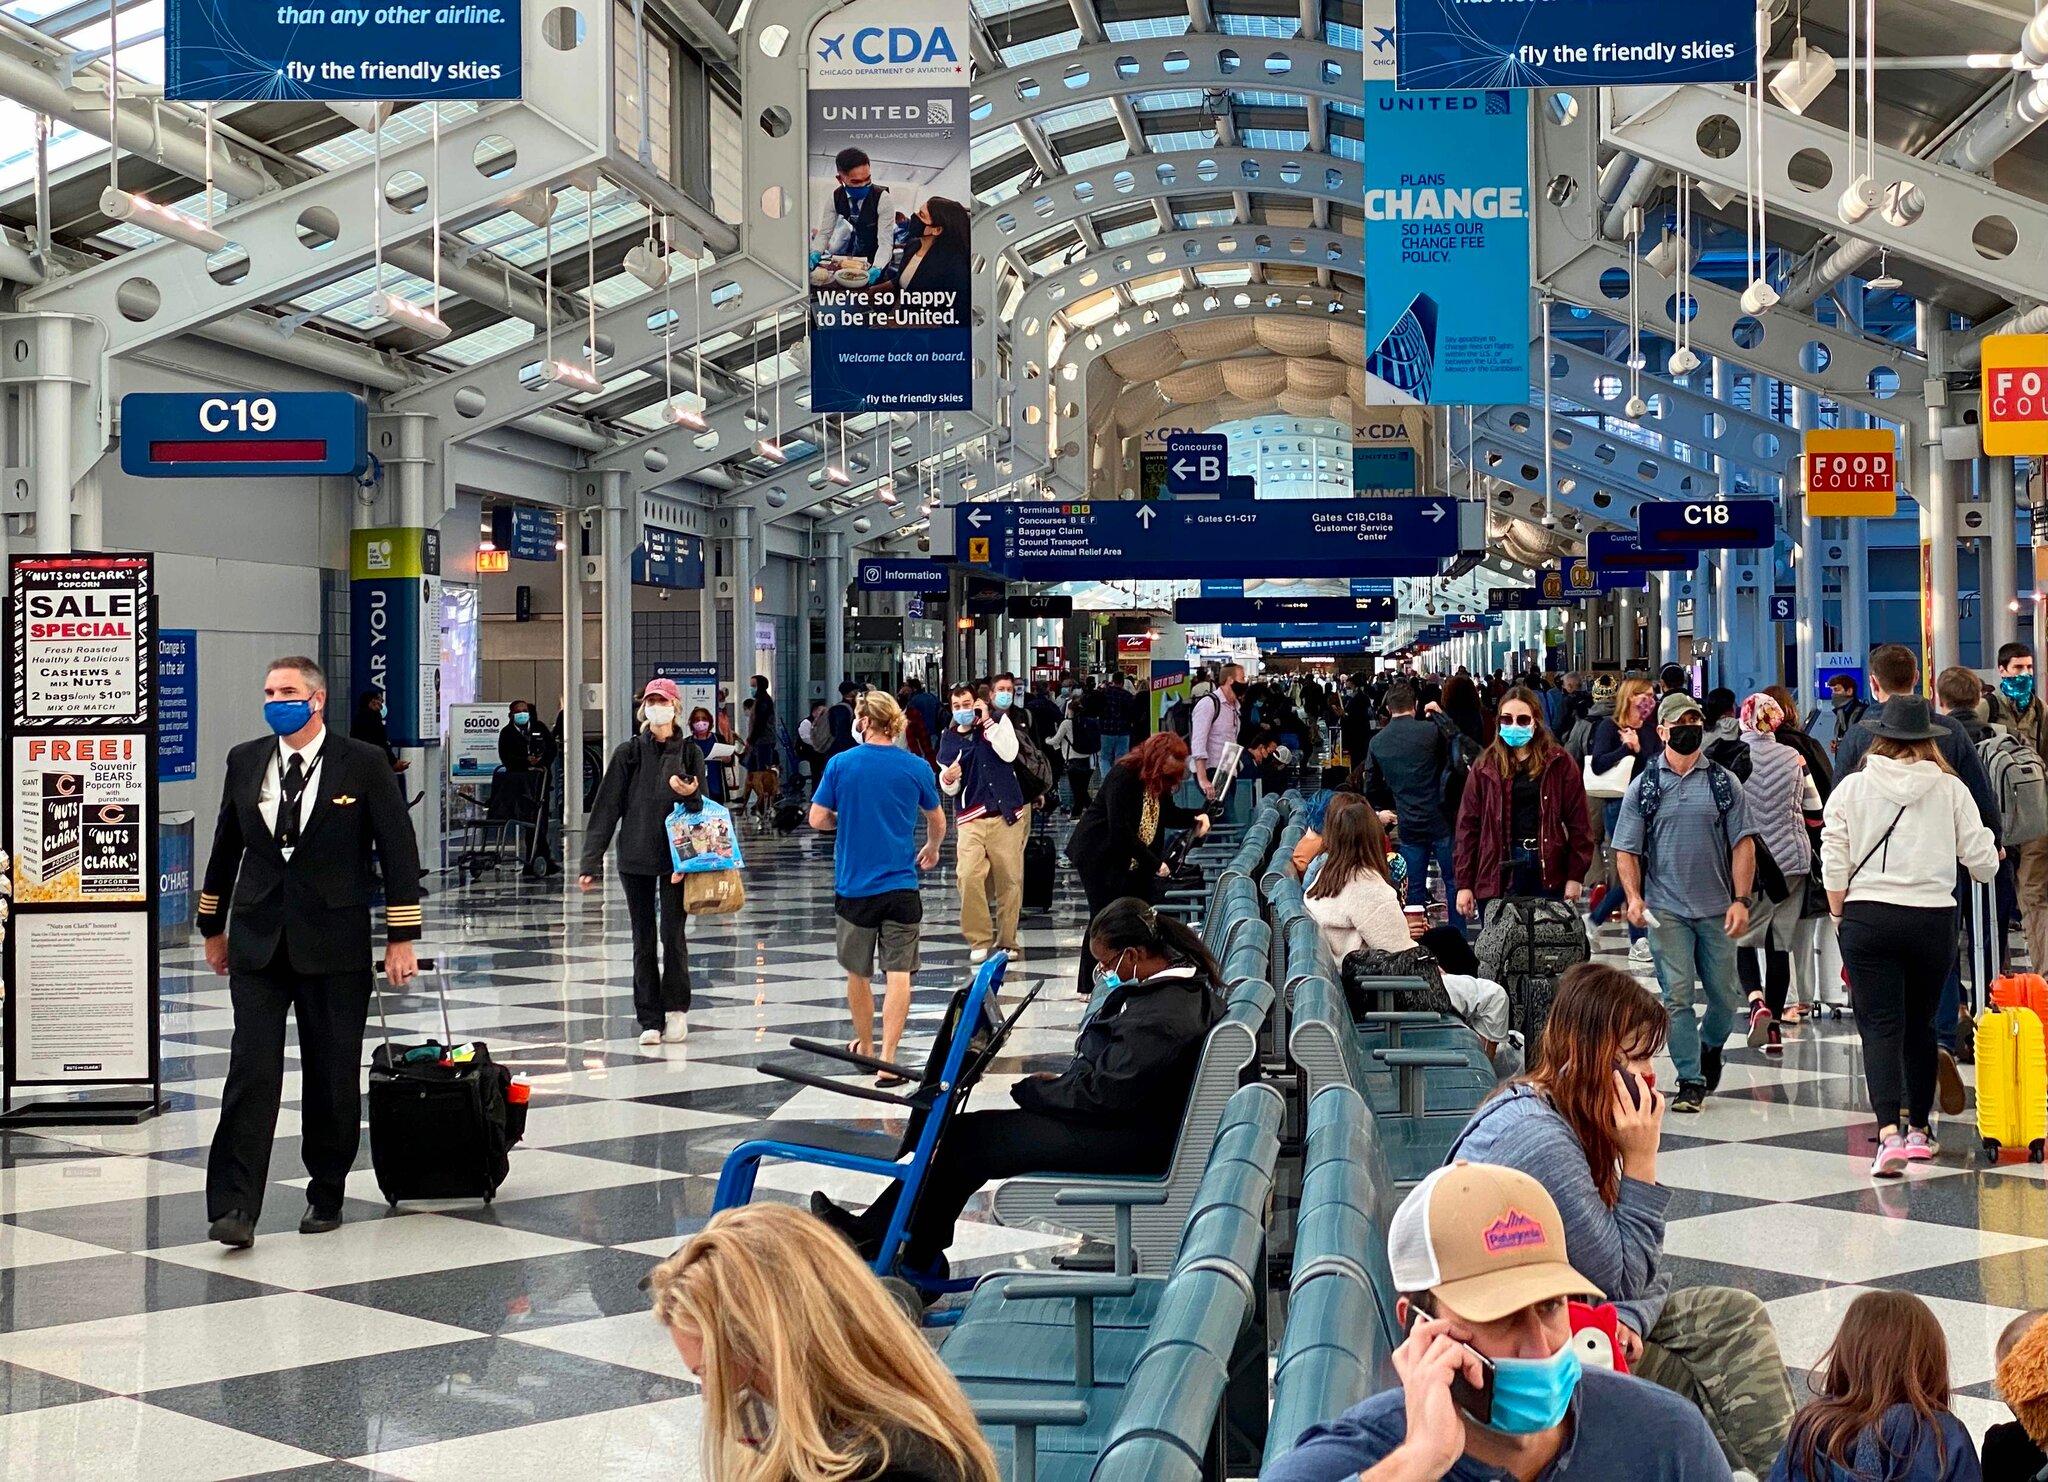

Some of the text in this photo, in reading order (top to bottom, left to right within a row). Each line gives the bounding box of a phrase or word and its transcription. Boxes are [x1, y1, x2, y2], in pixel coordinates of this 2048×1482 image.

[277, 5, 506, 28] than any other airline.
[852, 26, 958, 65] CDA
[1519, 40, 1735, 66] fly the friendly skies
[286, 61, 502, 83] fly the friendly skies
[917, 66, 952, 74] AVIATION
[1379, 96, 1478, 111] UNITED
[822, 105, 921, 121] UNITED
[1401, 174, 1446, 186] PLANS
[1364, 187, 1529, 221] CHANGE.
[1401, 222, 1484, 235] SO HAS OUR
[1401, 236, 1485, 249] CHANGE FEE
[1402, 251, 1451, 263] POLICY.
[817, 289, 957, 307] We're so happy
[817, 309, 960, 327] to be re-United.
[838, 352, 966, 363] Welcome back on board.
[866, 393, 964, 404] fly the friendly skies
[199, 398, 277, 433] C19
[1369, 424, 1409, 439] CDA
[1171, 443, 1223, 452] Concourse
[1200, 456, 1221, 482] B
[1815, 456, 1887, 474] FOOD
[1813, 474, 1891, 488] COURT
[1018, 506, 1060, 514] Terminals
[1683, 504, 1730, 525] C18
[1018, 517, 1067, 525] Concourses
[1197, 514, 1257, 523] Gates C1-C17
[1312, 513, 1393, 523] Gates C18,C18a
[1018, 527, 1083, 536] Baggage Claim
[1314, 523, 1394, 532] Customer Service
[1018, 537, 1089, 547] Ground Transport
[1357, 532, 1387, 541] Center
[1018, 547, 1122, 557] Service Animal Relief Area
[479, 552, 506, 567] EXIT
[26, 570, 63, 582] "NUTS
[884, 569, 942, 581] Information
[29, 594, 132, 618] SALE
[1030, 597, 1049, 607] C17
[1776, 599, 1788, 618] $
[370, 590, 387, 648] YOU
[1459, 614, 1476, 623] C16
[30, 623, 132, 638] SPECIAL
[159, 640, 186, 657] Change is
[31, 656, 70, 665] Healthy
[83, 655, 130, 663] Delicious
[1830, 656, 1853, 665] ATM
[40, 668, 109, 677] CASHEWS
[159, 660, 186, 675] in the air
[73, 678, 112, 687] NUTS
[31, 691, 96, 701] 2 bags/only
[29, 739, 133, 761] FREE!
[90, 762, 137, 771] Souvenir
[174, 764, 191, 773] UNITED
[94, 772, 133, 782] BEARS
[85, 781, 142, 790] Popcorn Box
[58, 820, 69, 830] ON
[102, 846, 116, 854] ON
[52, 851, 77, 867] POPCORN
[159, 870, 189, 893] O'HARE
